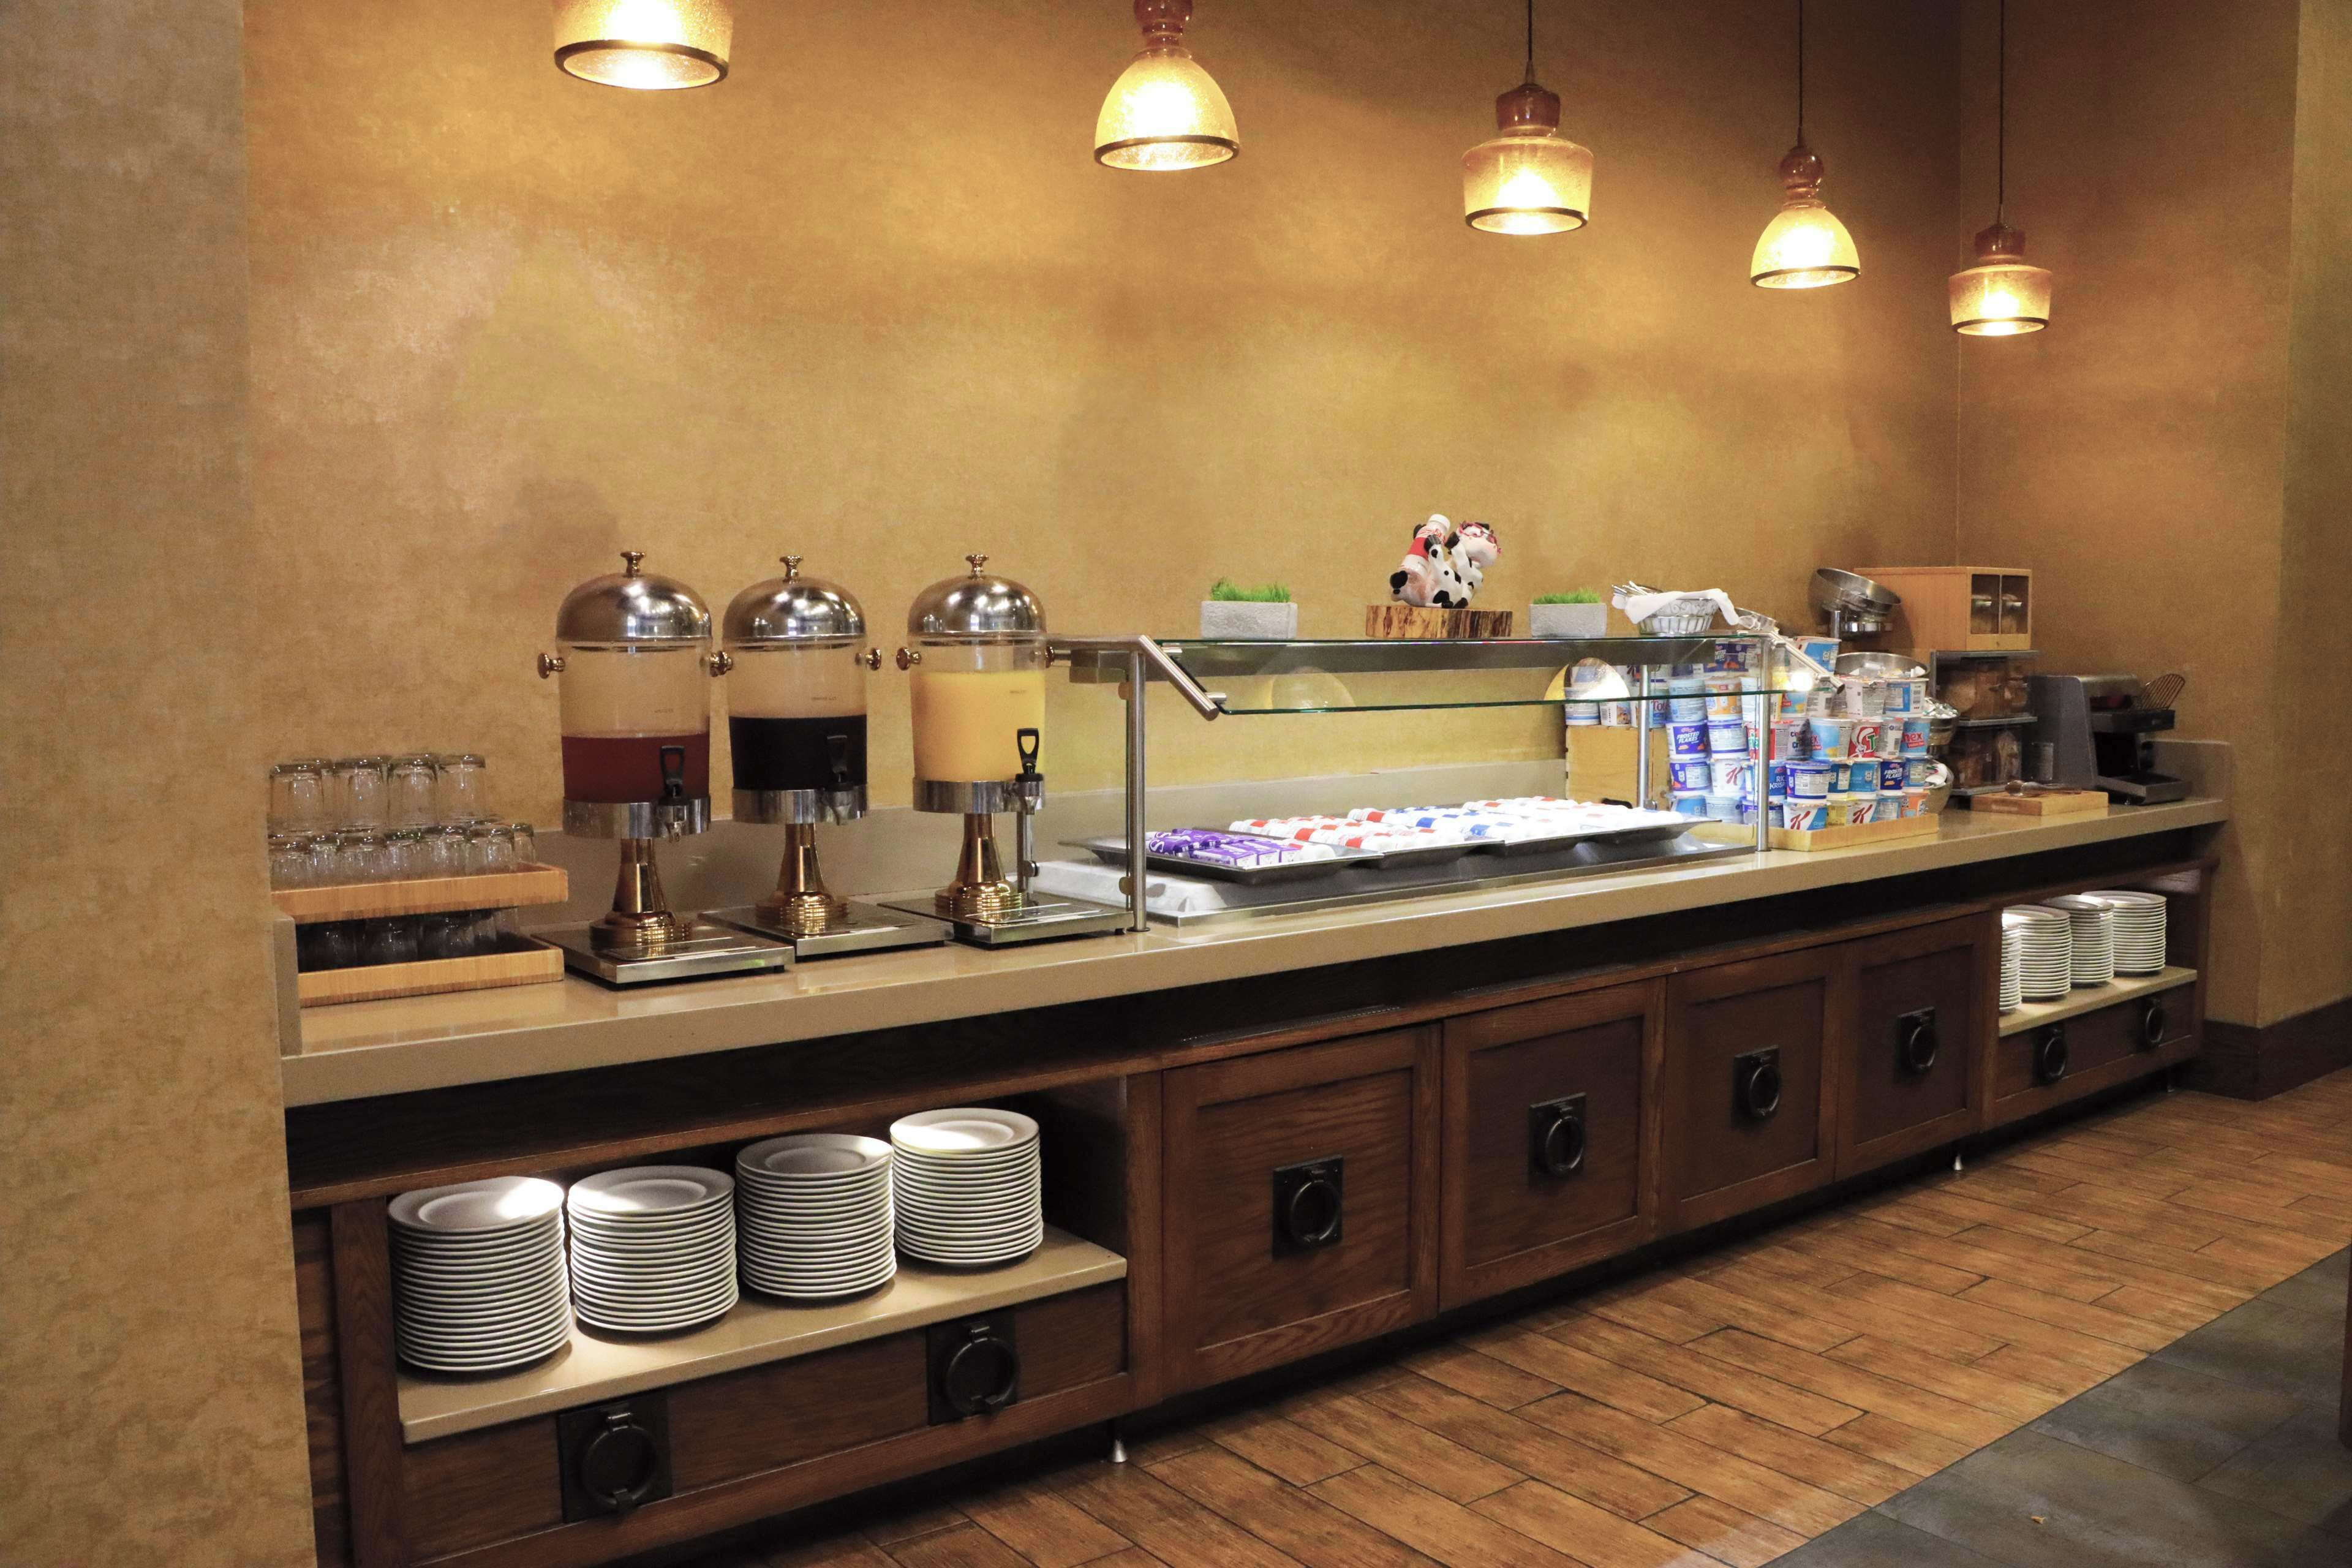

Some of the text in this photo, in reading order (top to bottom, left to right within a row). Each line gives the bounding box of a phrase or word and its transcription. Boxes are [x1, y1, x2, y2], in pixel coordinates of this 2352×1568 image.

[1725, 766, 1744, 786] K
[1790, 810, 1811, 831] K
[1852, 804, 1873, 824] K
